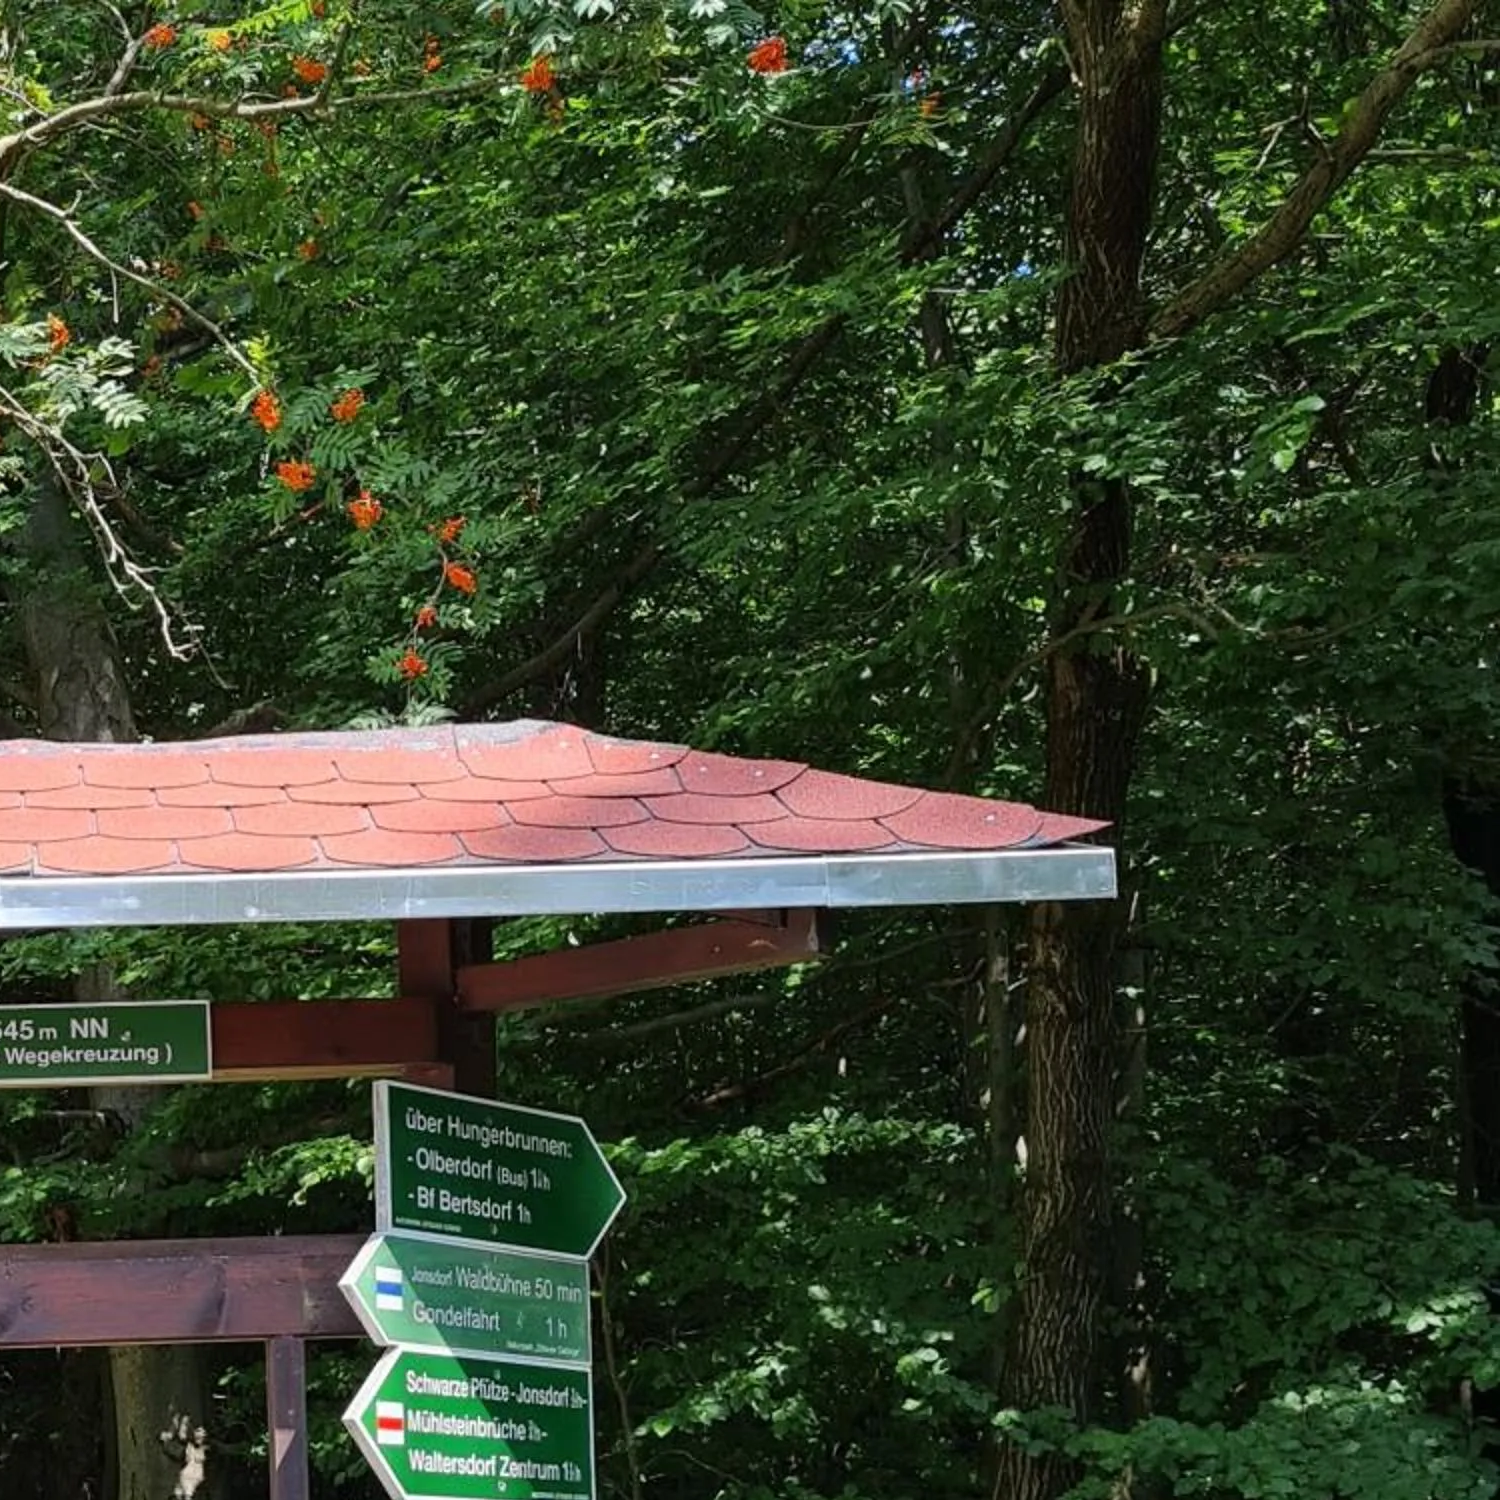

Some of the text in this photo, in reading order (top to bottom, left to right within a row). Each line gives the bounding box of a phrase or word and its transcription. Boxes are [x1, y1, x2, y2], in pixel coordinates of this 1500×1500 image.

[39, 1026, 58, 1040] m
[70, 1018, 109, 1039] NN
[4, 1044, 159, 1067] Wegekreuzung
[405, 1107, 573, 1159] über Hungerbrunnen:
[497, 1166, 529, 1191] (Bus)
[417, 1185, 435, 1209] Bf
[439, 1189, 513, 1221] Bertsdorf
[411, 1265, 582, 1304] Jonsdorf Waldbühne 50 min
[413, 1301, 501, 1332] Gondelfahrt
[406, 1369, 469, 1398] Schwarze
[470, 1378, 509, 1402] Pfütze
[516, 1381, 570, 1408] Jonsdorf
[407, 1408, 527, 1441] Mühlsteinbrüche
[408, 1448, 497, 1477] Waltersdorf
[499, 1455, 561, 1480] Zentrum
